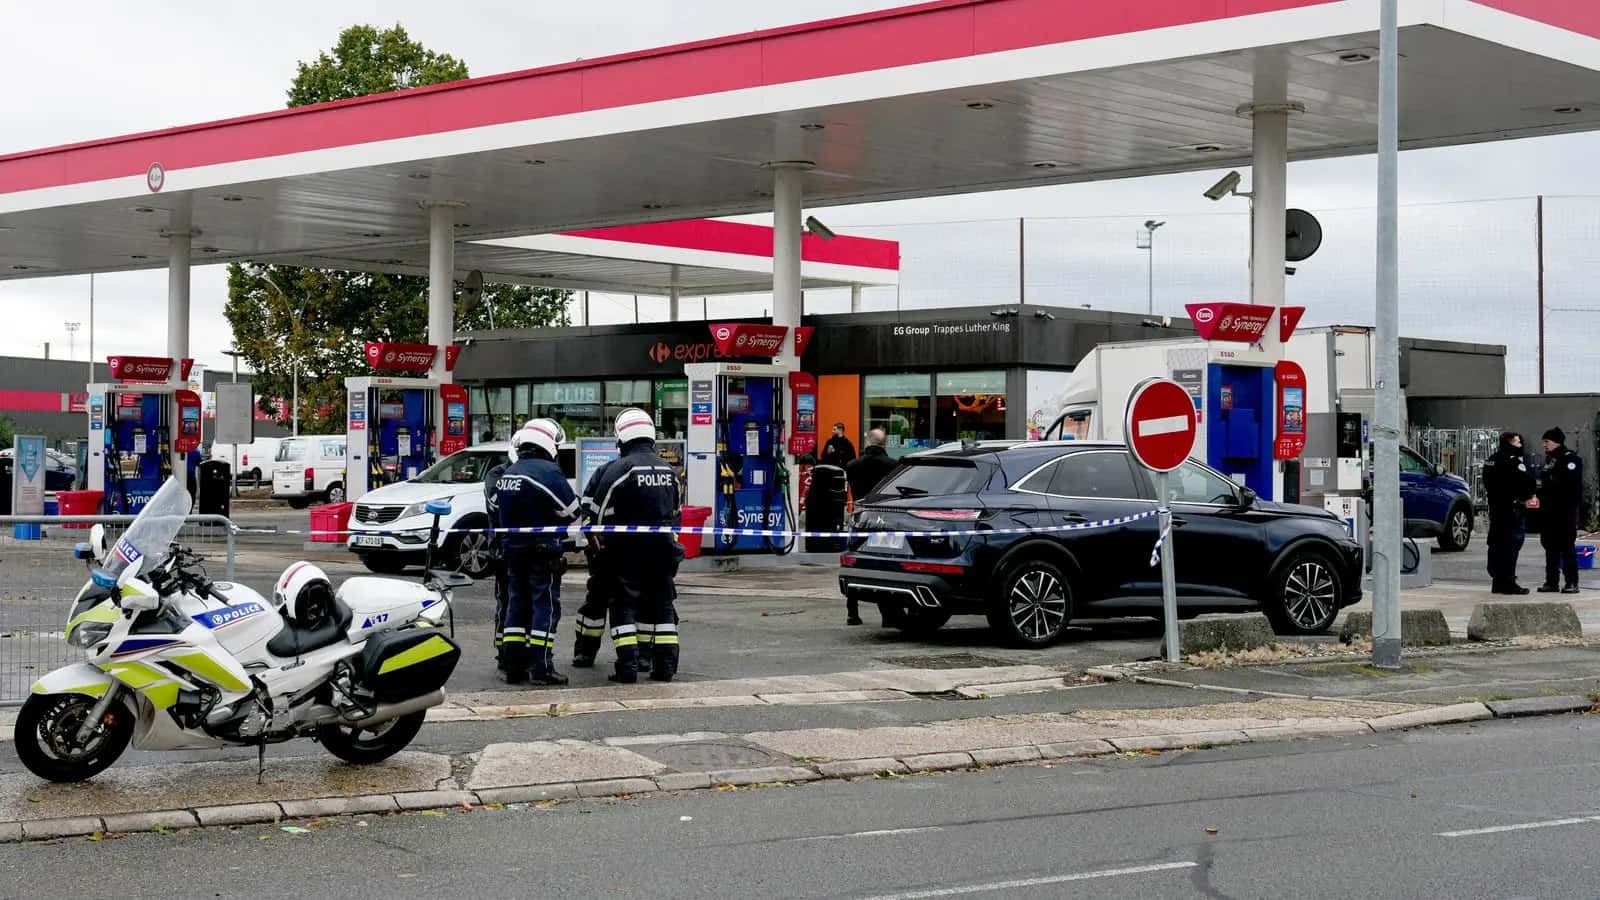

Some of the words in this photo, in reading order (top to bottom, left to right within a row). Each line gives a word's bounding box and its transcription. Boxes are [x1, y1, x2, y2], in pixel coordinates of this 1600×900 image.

[1231, 318, 1265, 334] Synergy
[1283, 315, 1288, 326] 1
[894, 326, 904, 335] EG
[905, 326, 930, 336] Group
[933, 324, 964, 335] Trappes
[965, 322, 990, 333] Luther
[992, 321, 1010, 333] King
[747, 338, 779, 350] Synergy
[796, 333, 803, 343] 3
[397, 353, 431, 366] Synergy
[136, 364, 168, 376] Synergy
[637, 474, 673, 487] POLICE
[737, 508, 782, 528] Synegy
[224, 604, 260, 621] POLICE
